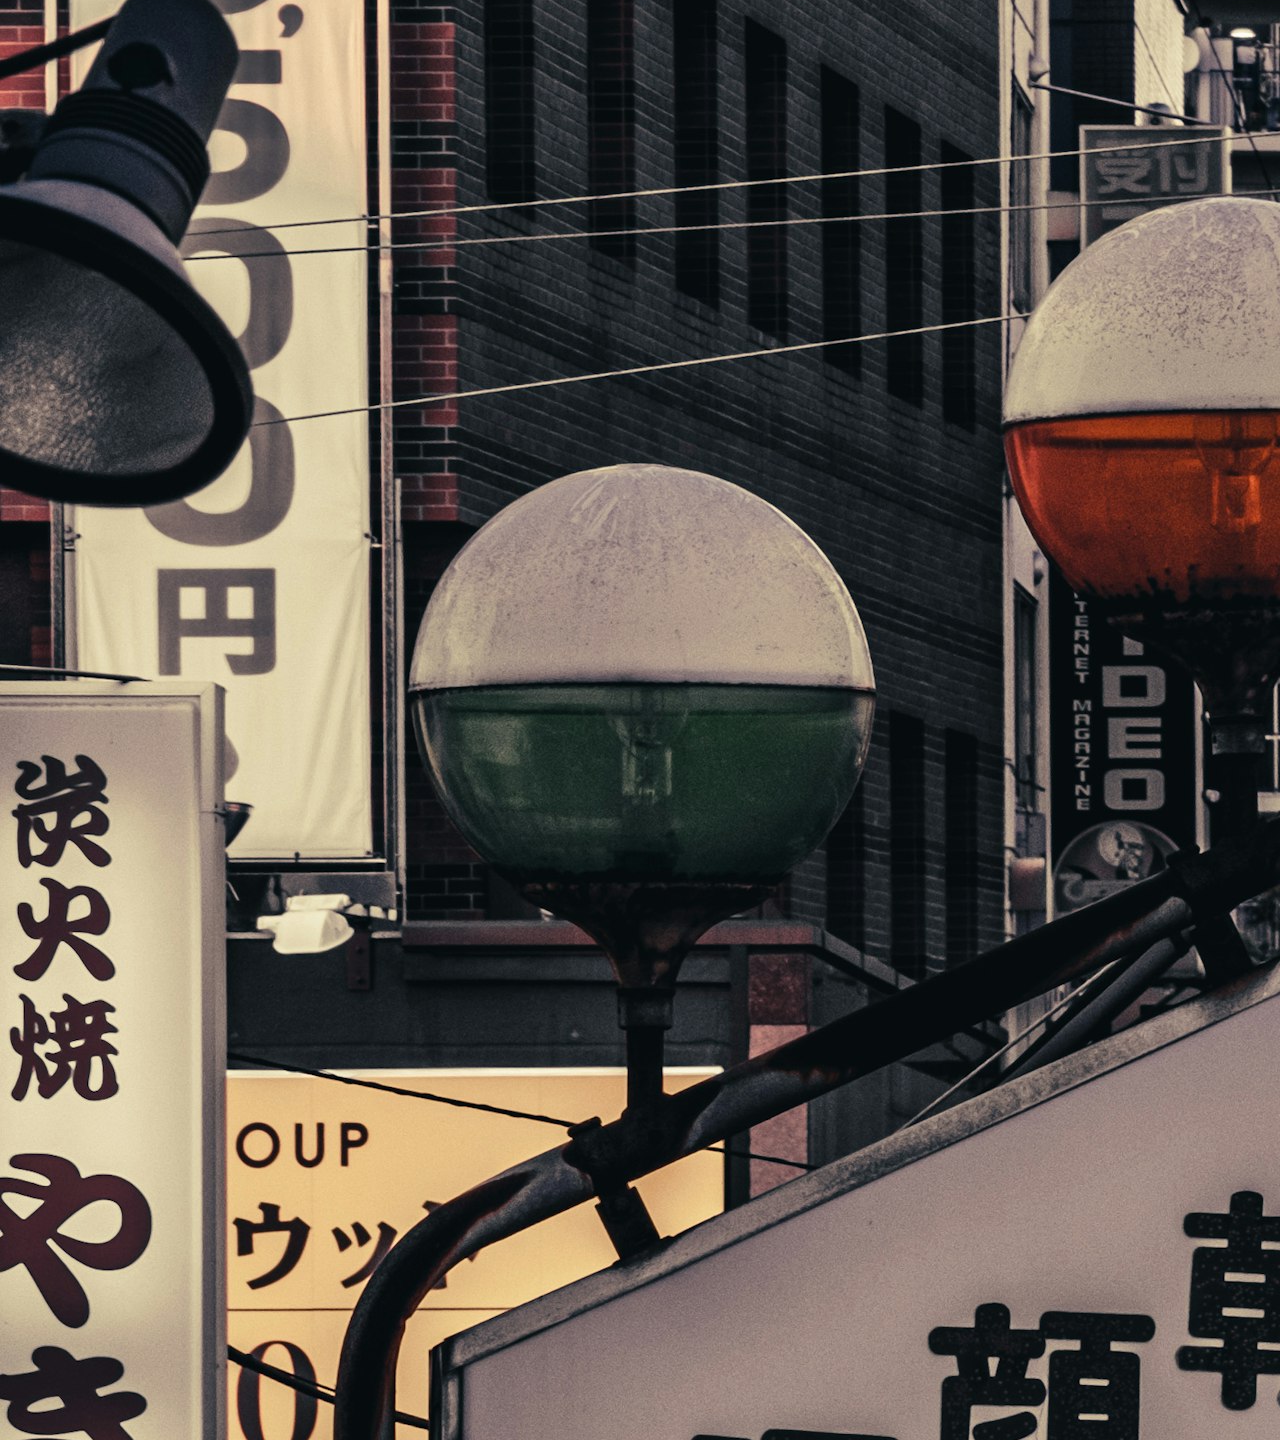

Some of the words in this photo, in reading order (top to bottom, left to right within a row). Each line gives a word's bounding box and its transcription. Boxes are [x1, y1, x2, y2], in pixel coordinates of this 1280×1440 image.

[1072, 699, 1092, 812] MAGAZINE
[11, 754, 119, 1101] 炭火焼
